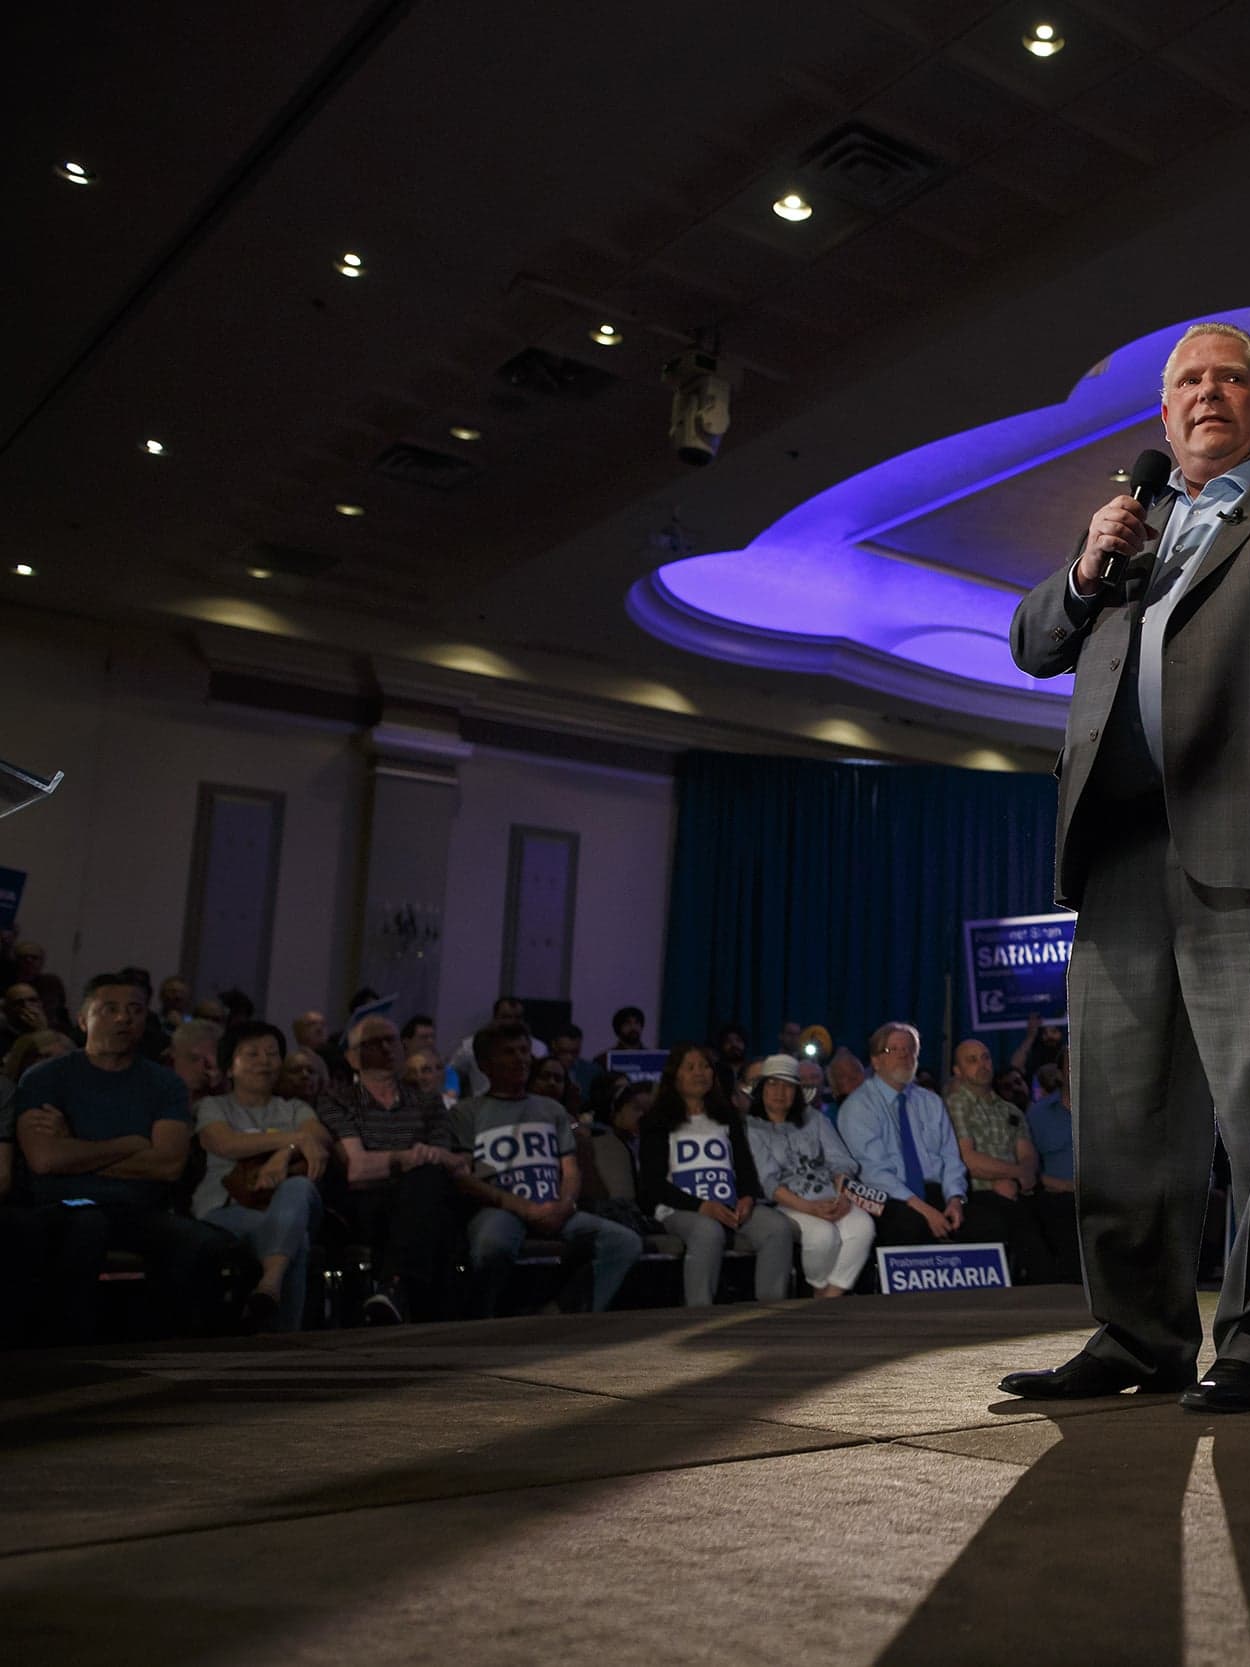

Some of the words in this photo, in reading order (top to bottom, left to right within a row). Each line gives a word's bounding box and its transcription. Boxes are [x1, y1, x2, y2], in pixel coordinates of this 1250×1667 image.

[677, 1139, 728, 1164] DO
[499, 1169, 526, 1184] OR
[695, 1170, 729, 1183] FOR
[847, 1180, 888, 1204] FORD
[892, 1265, 1002, 1291] SARKARIA
